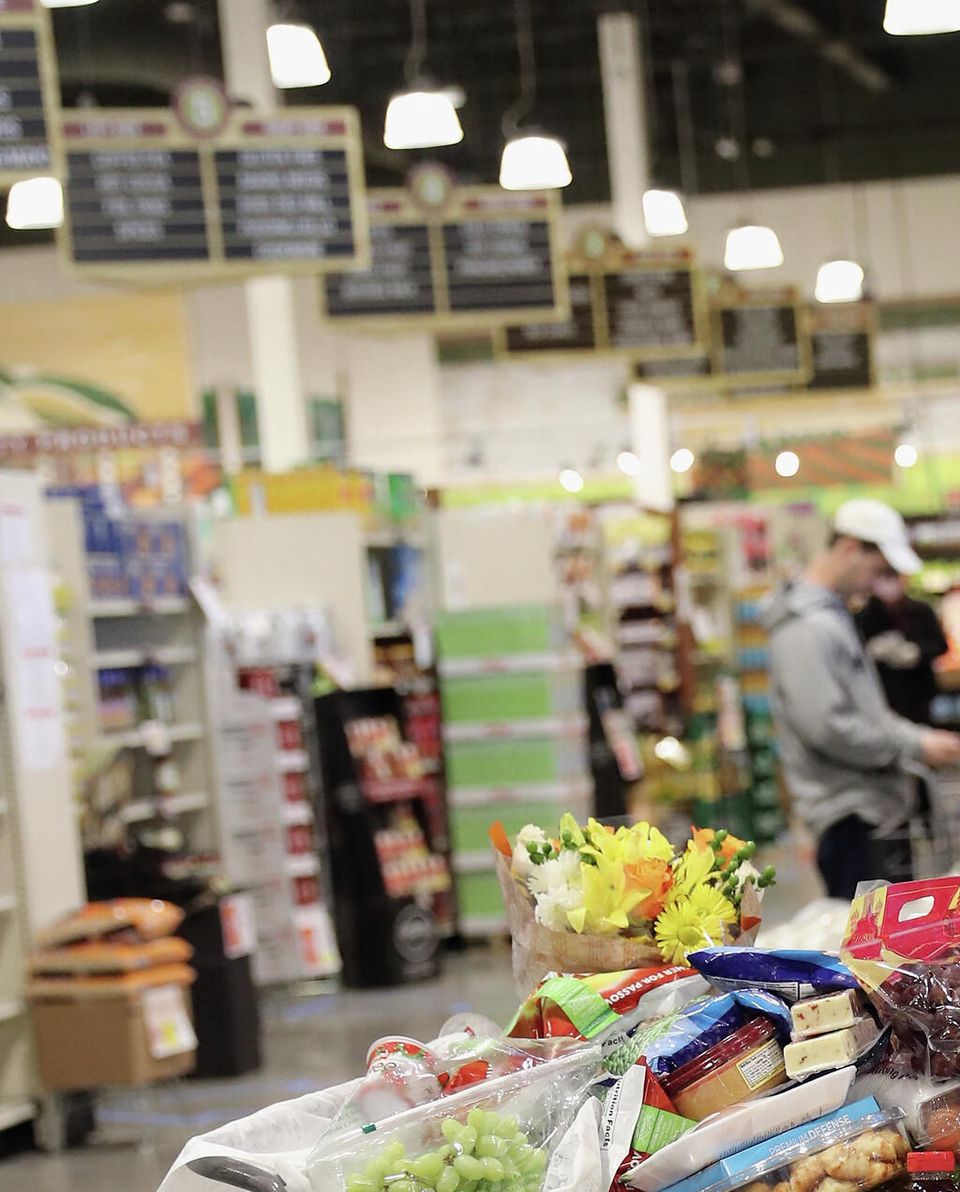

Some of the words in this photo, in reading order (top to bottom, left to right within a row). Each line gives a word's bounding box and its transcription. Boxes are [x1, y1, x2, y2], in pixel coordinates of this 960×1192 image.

[606, 1079, 622, 1117] utrition
[602, 1118, 614, 1148] Facts
[808, 1113, 851, 1141] DEFENSE
